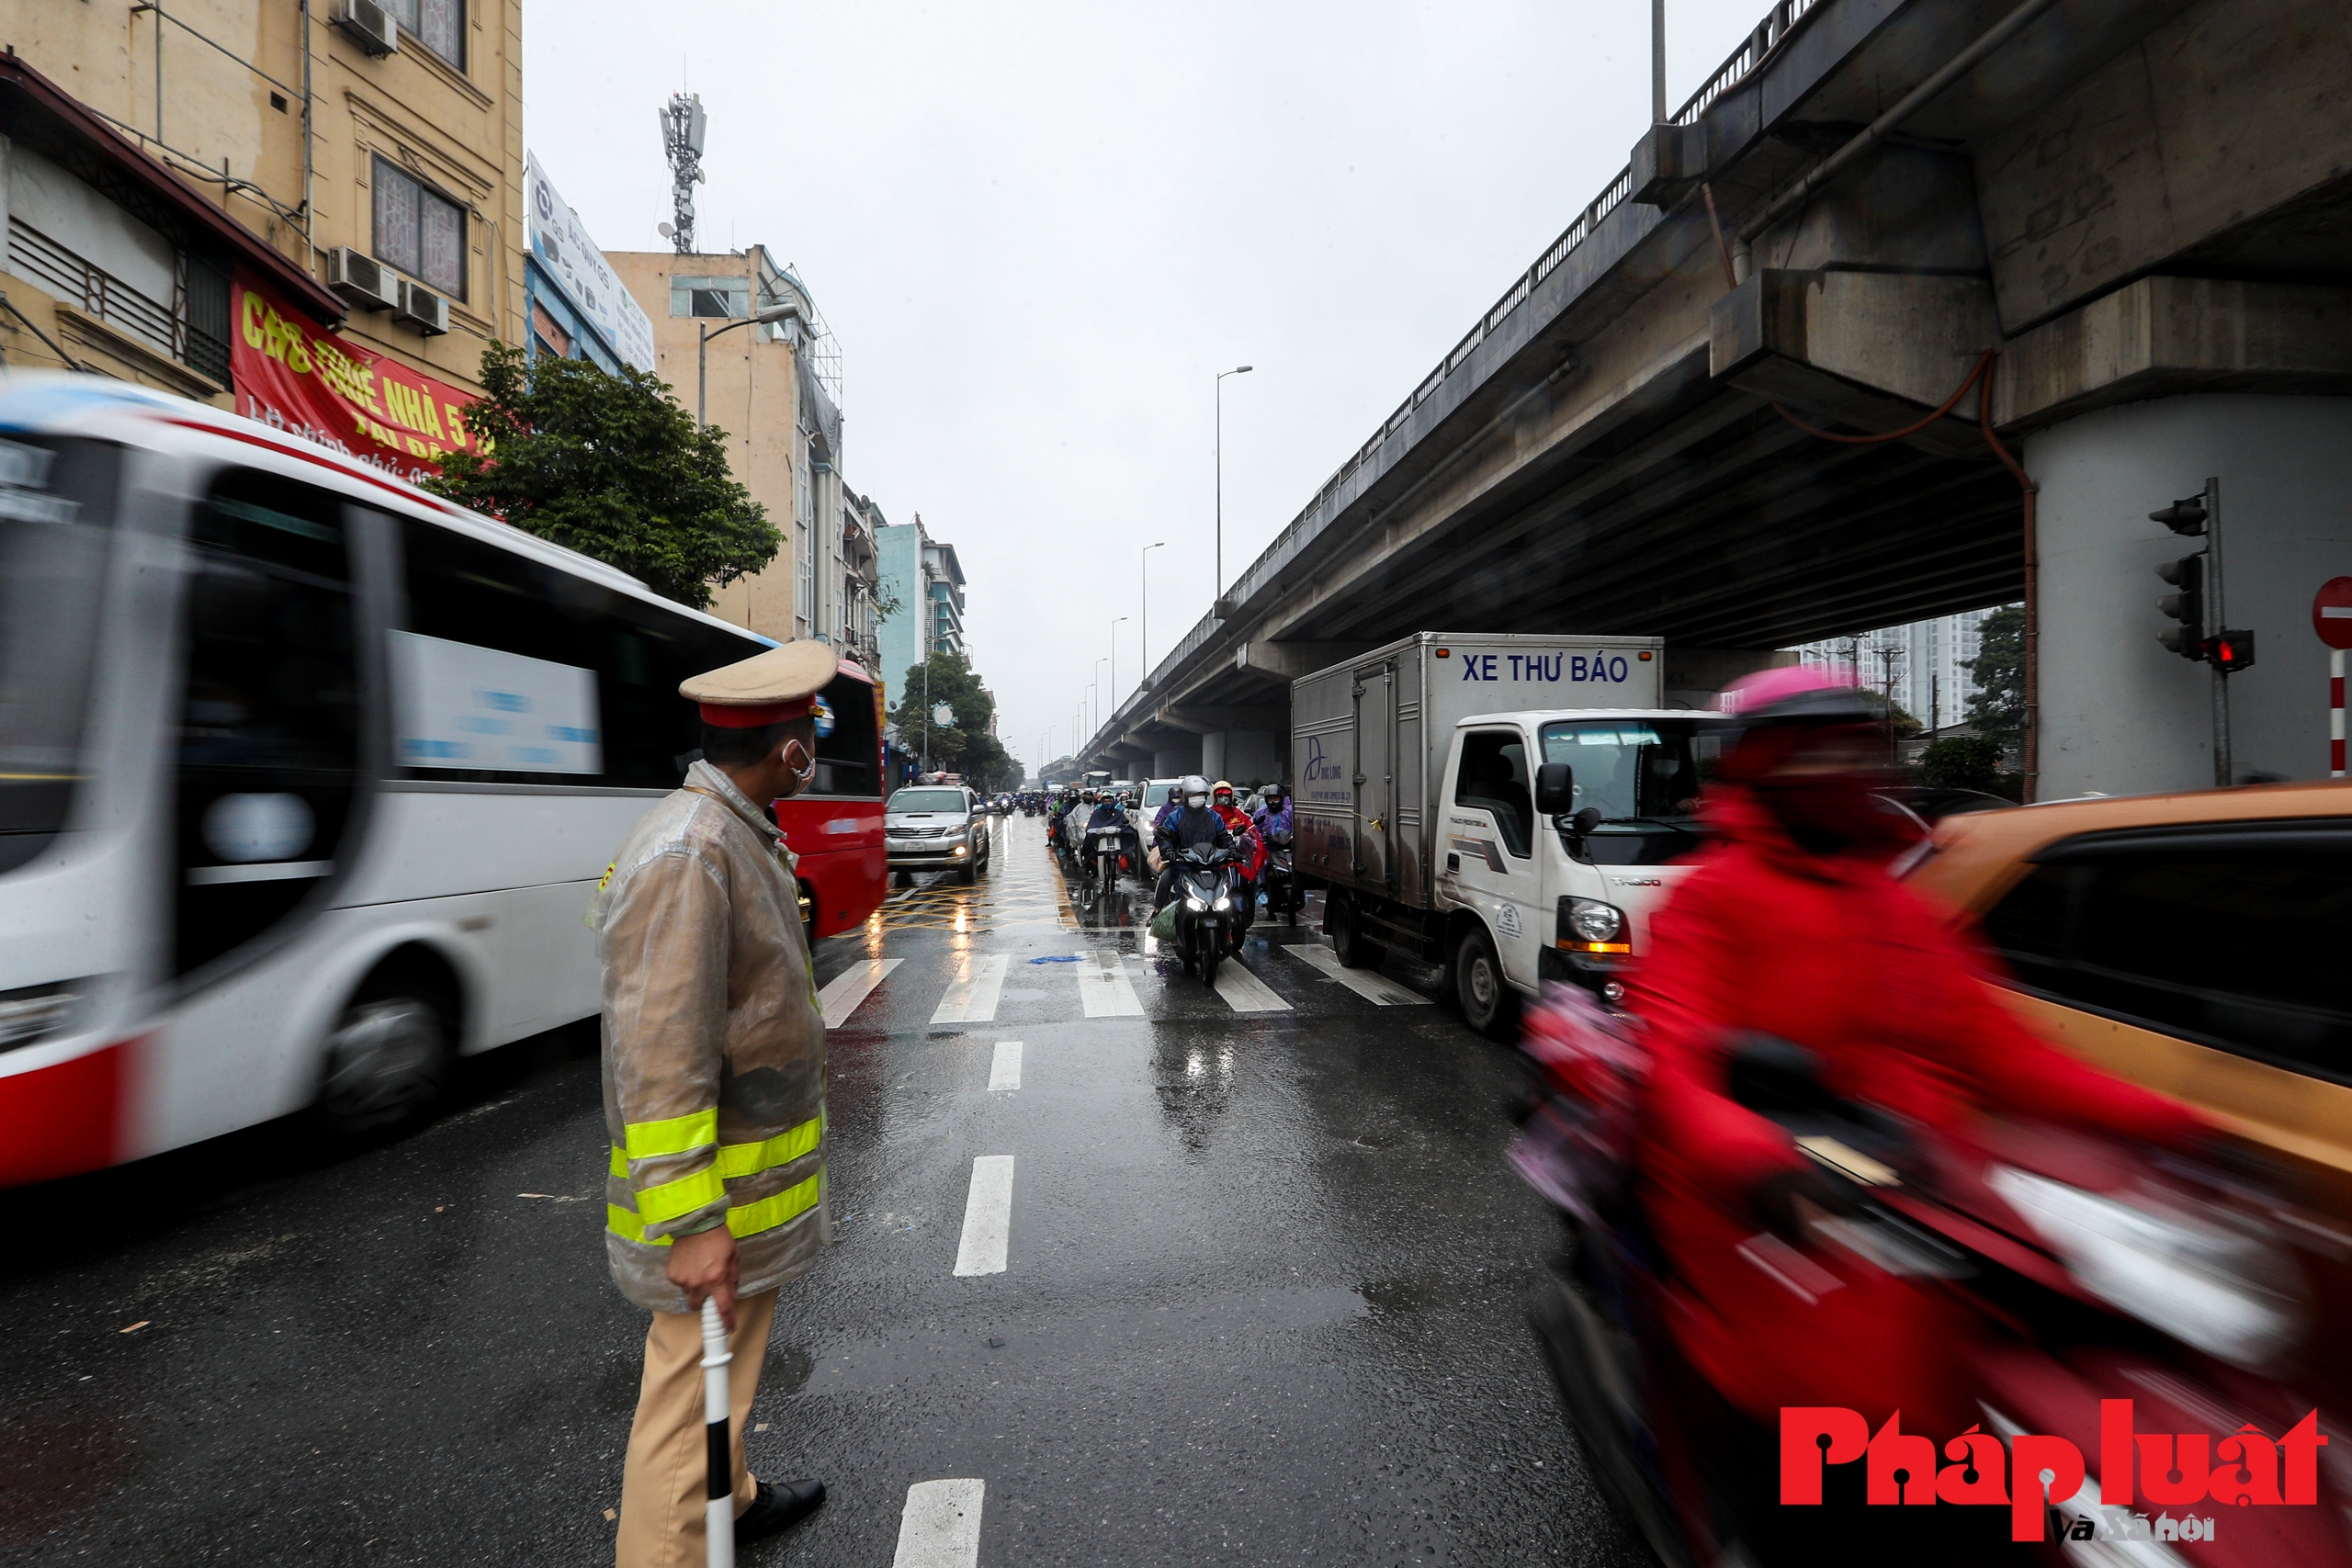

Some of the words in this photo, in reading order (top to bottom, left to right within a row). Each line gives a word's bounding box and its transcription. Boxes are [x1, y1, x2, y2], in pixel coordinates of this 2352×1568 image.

[552, 219, 565, 243] GS
[597, 265, 609, 290] GS
[313, 339, 384, 417] THUÊ
[383, 376, 446, 441] NHÀ
[445, 403, 467, 447] 5
[248, 395, 284, 430] LH
[350, 410, 401, 450] TẠI
[406, 436, 453, 464] ĐÂ
[1463, 655, 1498, 682] XE
[1508, 652, 1563, 682] THƯ
[1571, 650, 1628, 683] BÁO
[1611, 877, 1661, 886] THACO
